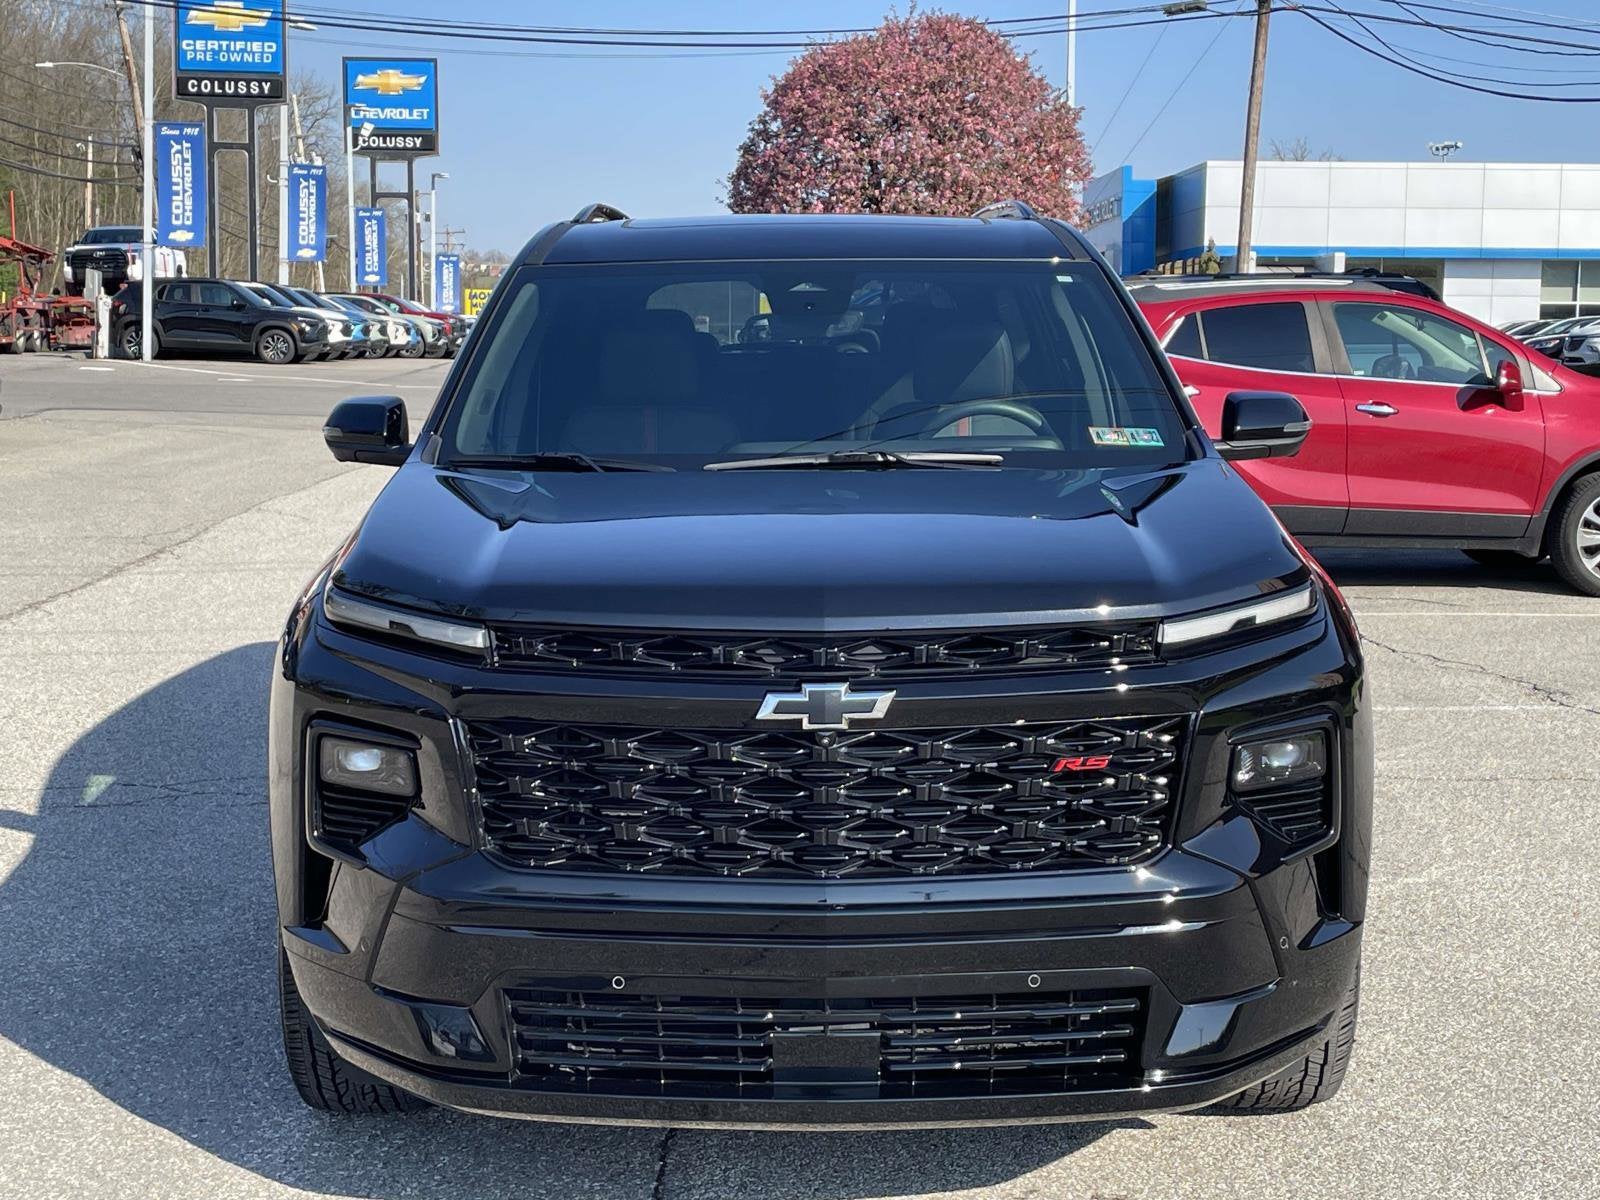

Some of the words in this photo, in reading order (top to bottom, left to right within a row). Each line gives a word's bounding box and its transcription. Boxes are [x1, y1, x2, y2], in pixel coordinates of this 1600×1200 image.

[182, 40, 277, 52] CERTIFIED
[187, 51, 272, 63] PRE-OWNED
[188, 80, 271, 94] COLUSSY
[351, 107, 430, 119] CHEVROLET
[183, 128, 200, 136] 1918
[358, 136, 423, 147] COLUSSY
[170, 140, 182, 226] COLUSSY
[183, 140, 192, 226] CHEVROLET
[299, 178, 308, 245] COLUSSY
[309, 178, 317, 245] CHEVROLET
[1052, 754, 1113, 772] RS
